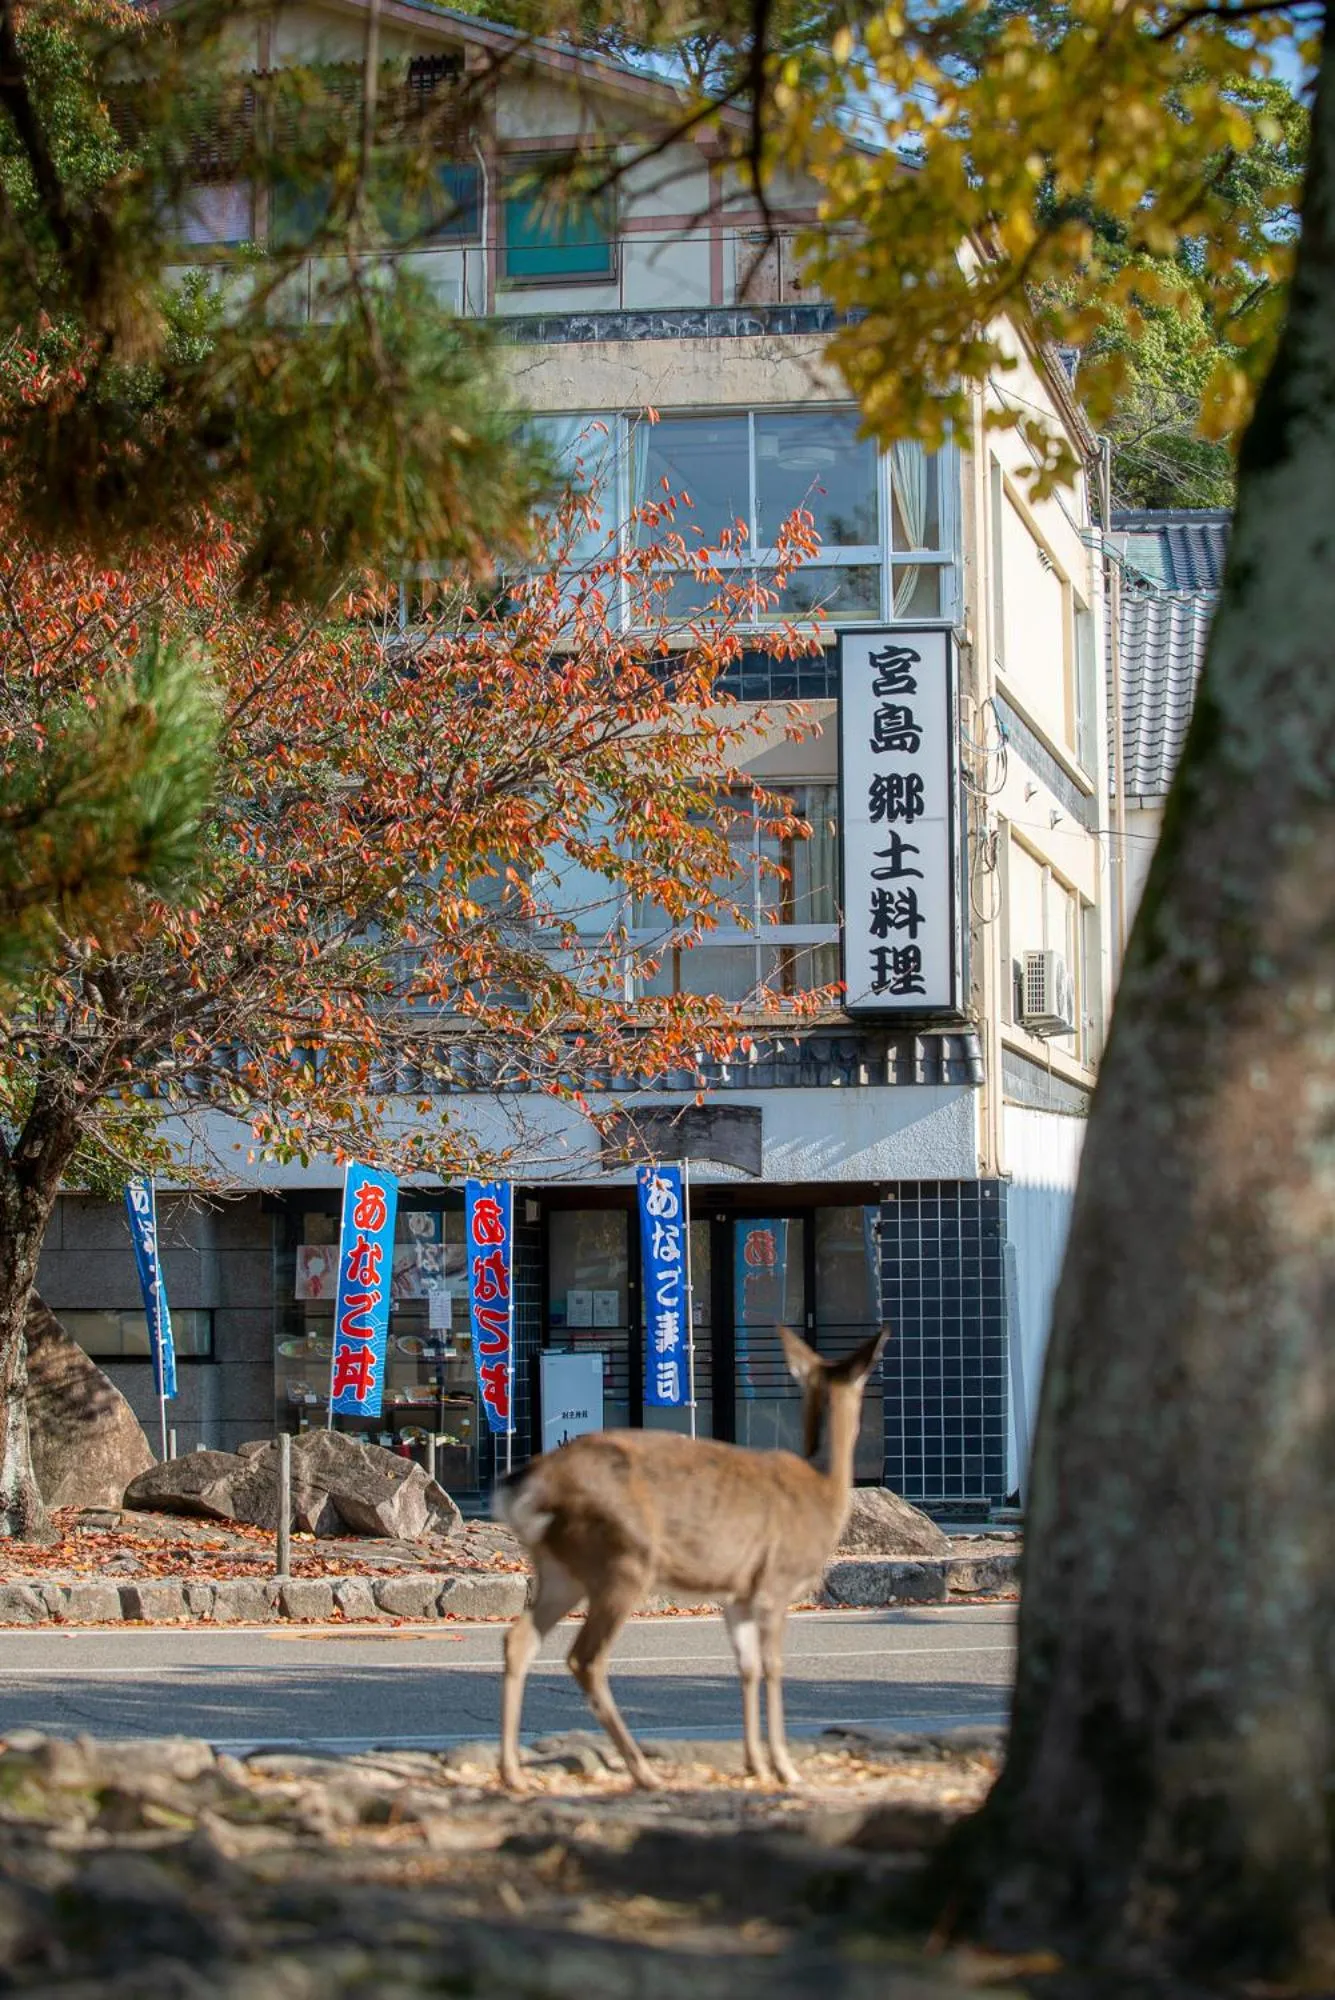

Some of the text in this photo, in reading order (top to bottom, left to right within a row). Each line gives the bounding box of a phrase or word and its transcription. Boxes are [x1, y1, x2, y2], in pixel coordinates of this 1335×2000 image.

[868, 644, 927, 996] 宮島郷土料理
[332, 1181, 387, 1401] あなご丼
